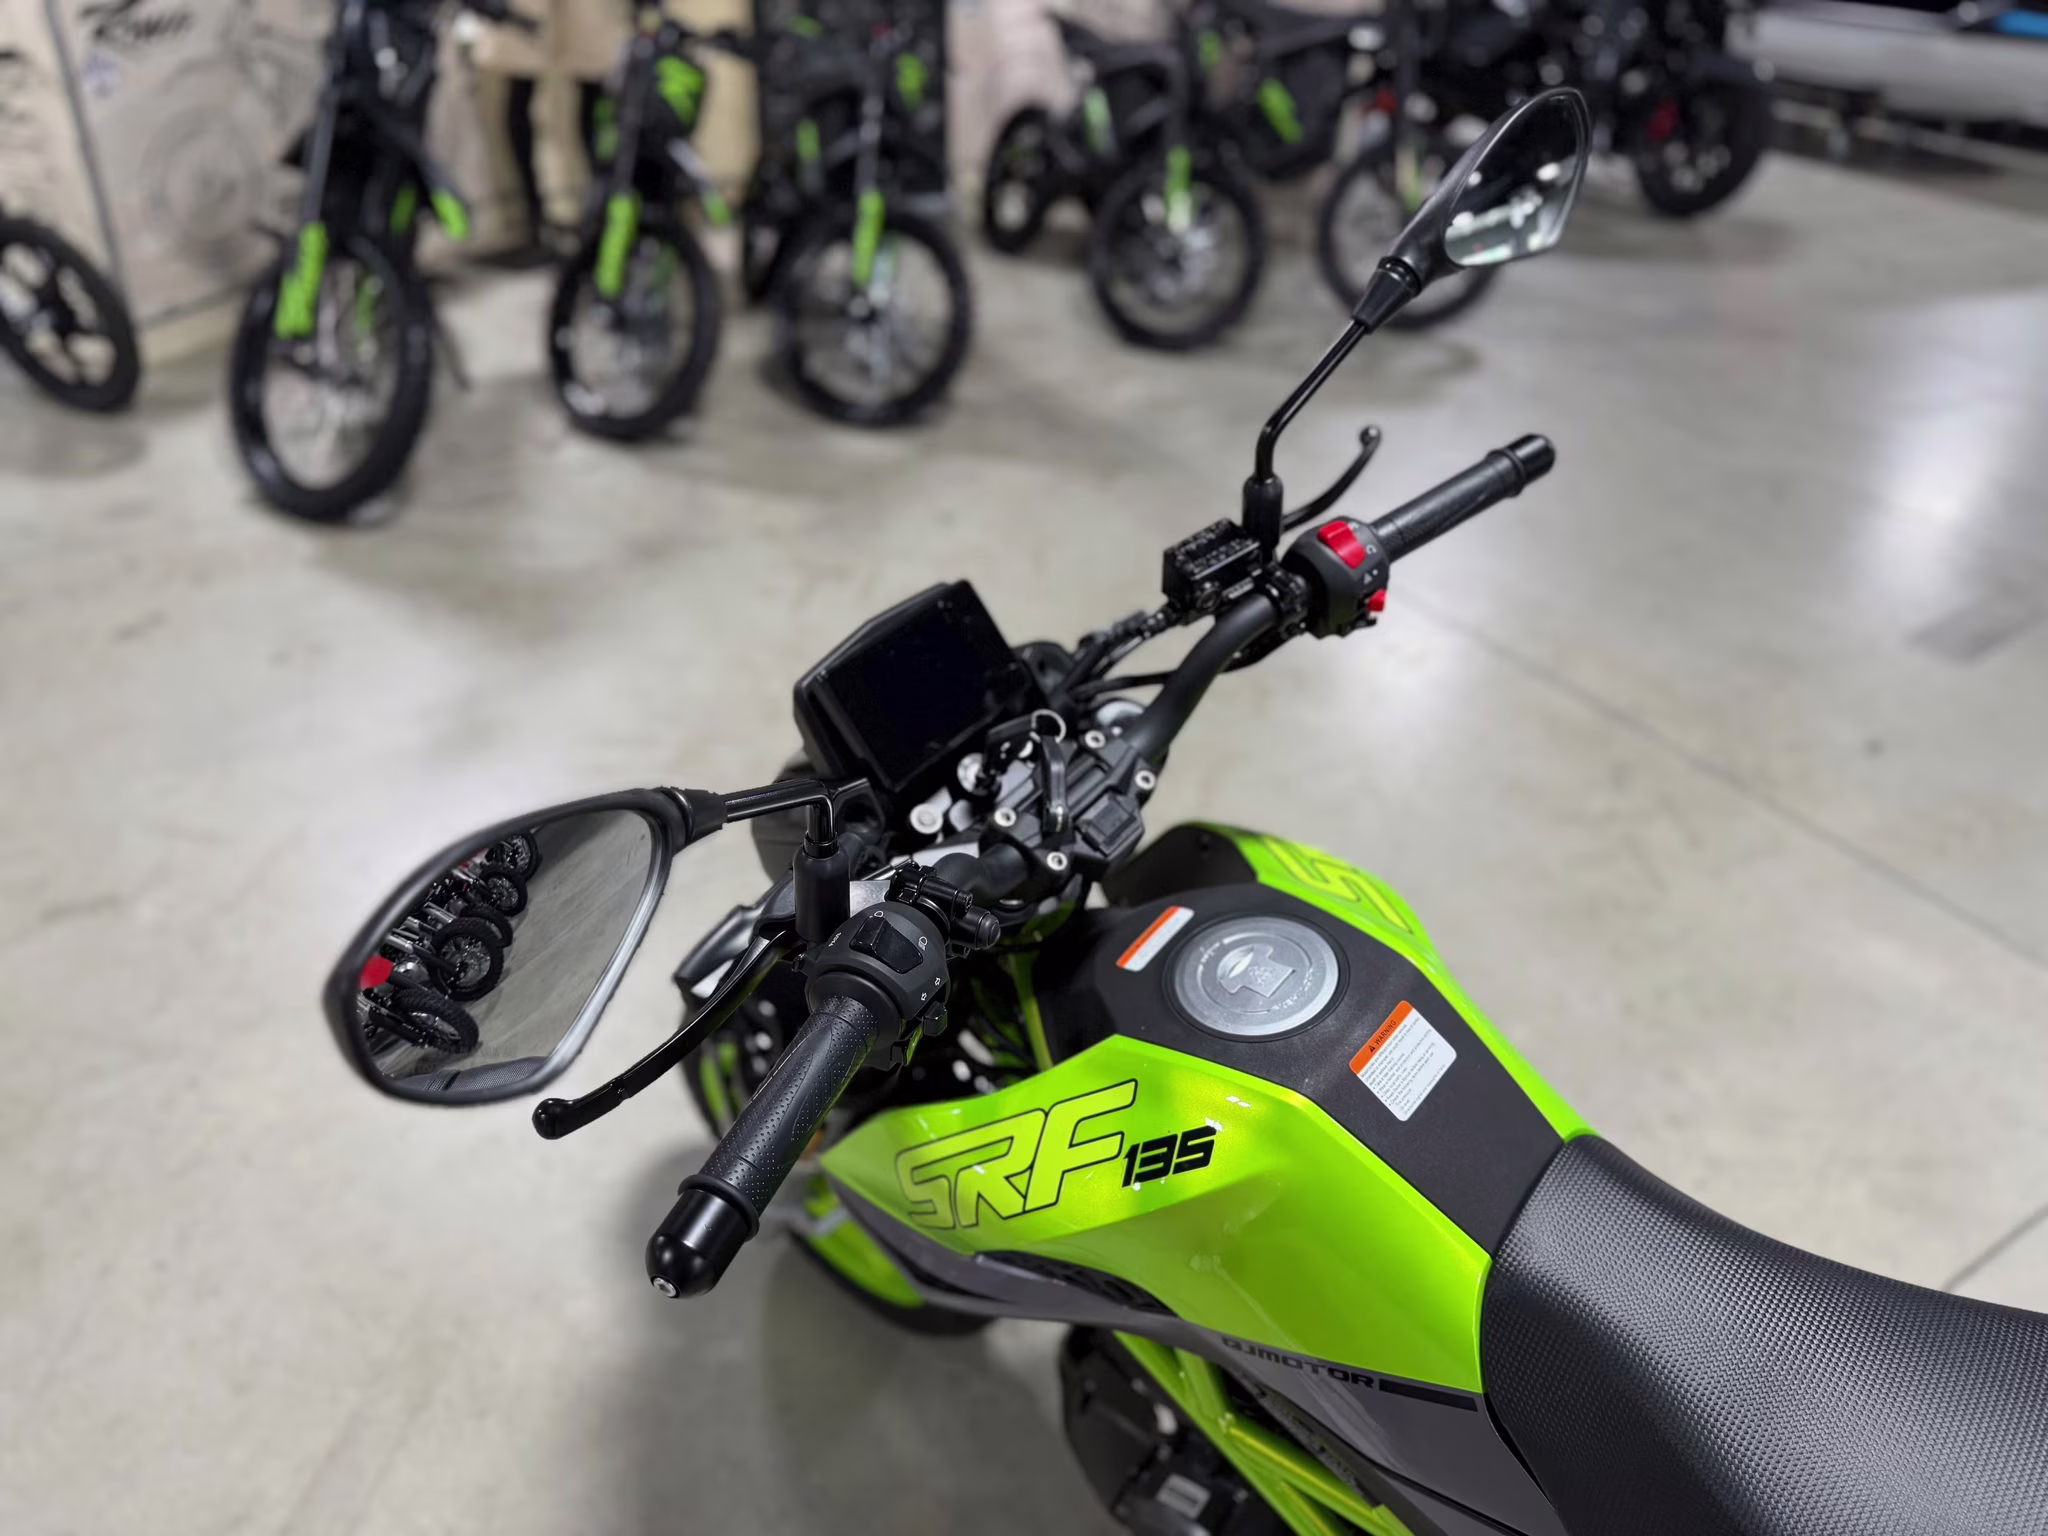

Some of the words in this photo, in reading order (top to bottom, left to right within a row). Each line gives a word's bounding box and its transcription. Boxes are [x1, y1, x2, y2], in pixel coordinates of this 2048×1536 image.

[1374, 1019, 1396, 1045] WARNING
[895, 1078, 1138, 1230] SRF
[1122, 1125, 1217, 1187] 135
